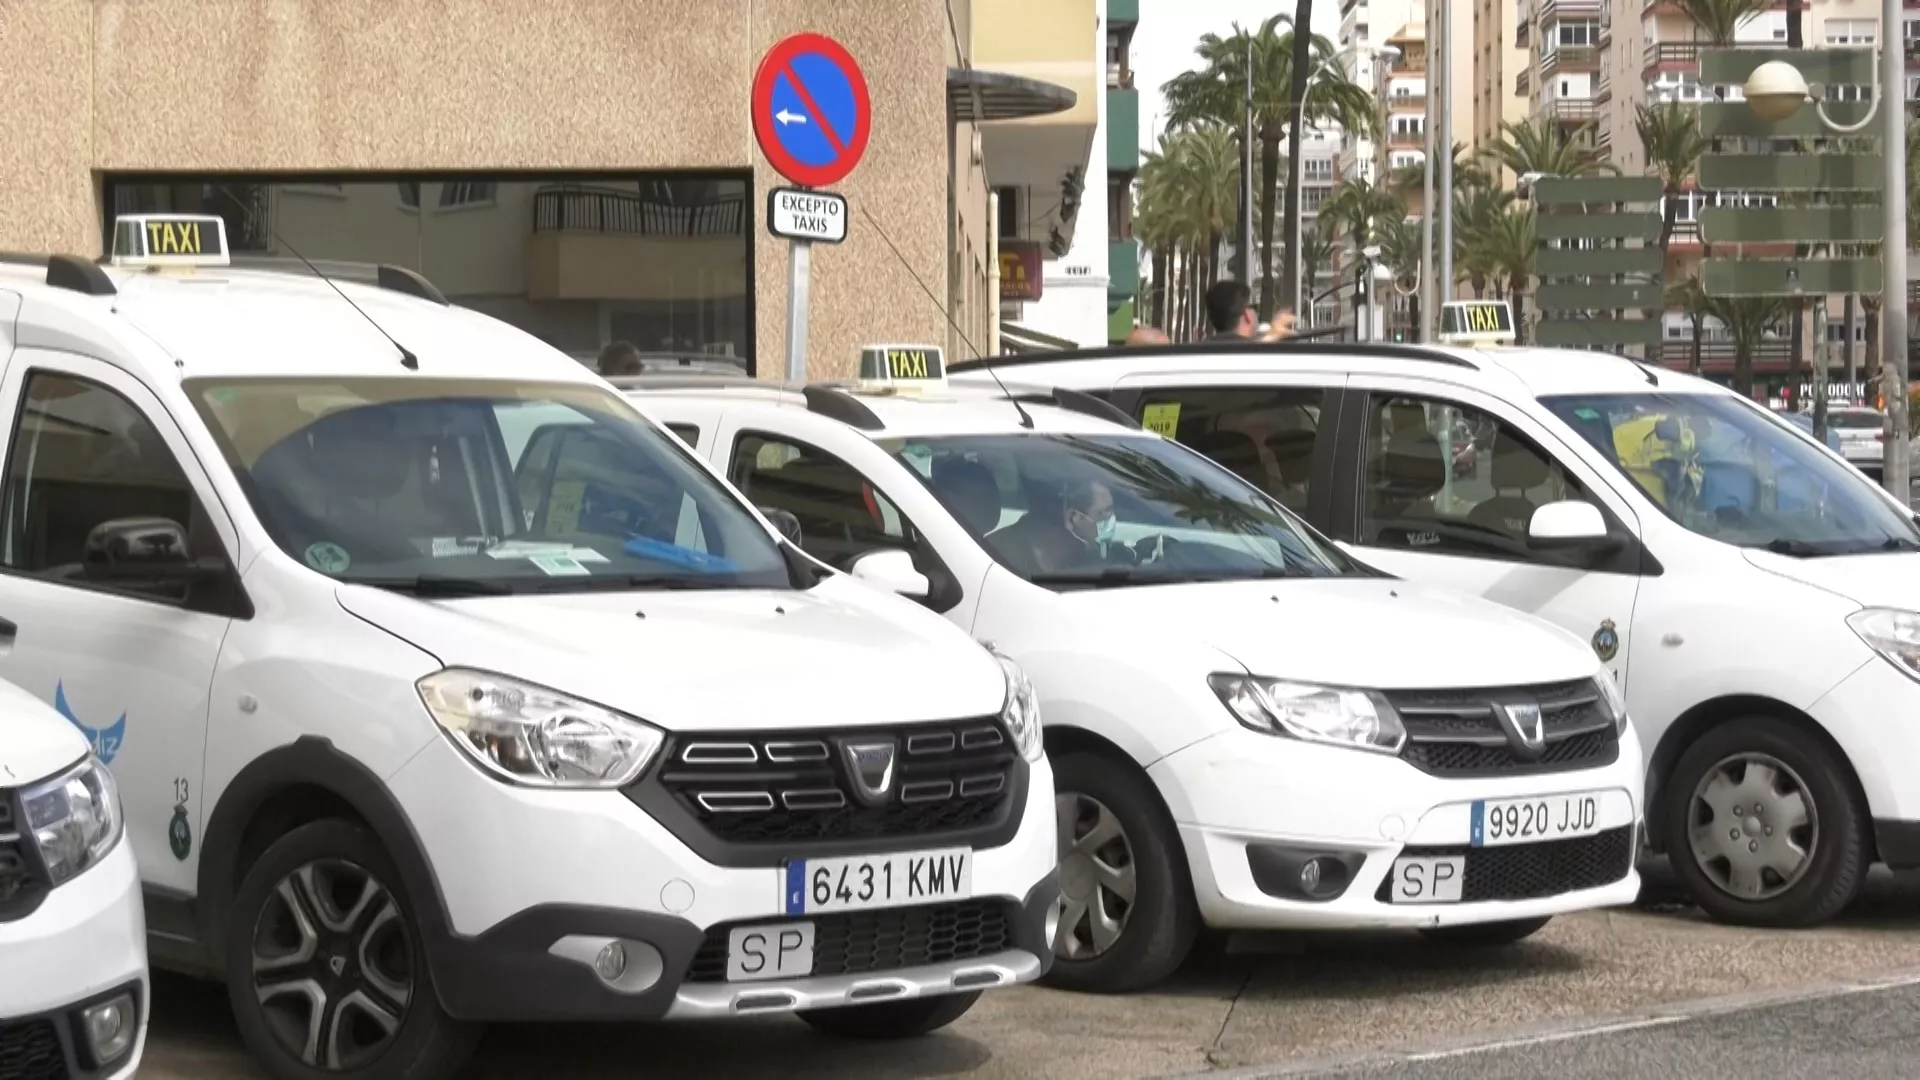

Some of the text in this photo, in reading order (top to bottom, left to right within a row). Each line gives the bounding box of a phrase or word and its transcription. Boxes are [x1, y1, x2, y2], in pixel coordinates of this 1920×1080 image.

[782, 195, 839, 216] EXCEPTO
[147, 221, 201, 253] TAXI
[792, 213, 828, 233] TAXIS
[1466, 304, 1499, 331] TAXI
[887, 350, 928, 378] TAXI
[174, 777, 189, 805] 13
[1490, 801, 1549, 838] 9920
[1557, 797, 1596, 832] JJD
[812, 853, 965, 906] 6431 KMV
[1402, 862, 1455, 897] SP
[740, 929, 804, 973] SP
